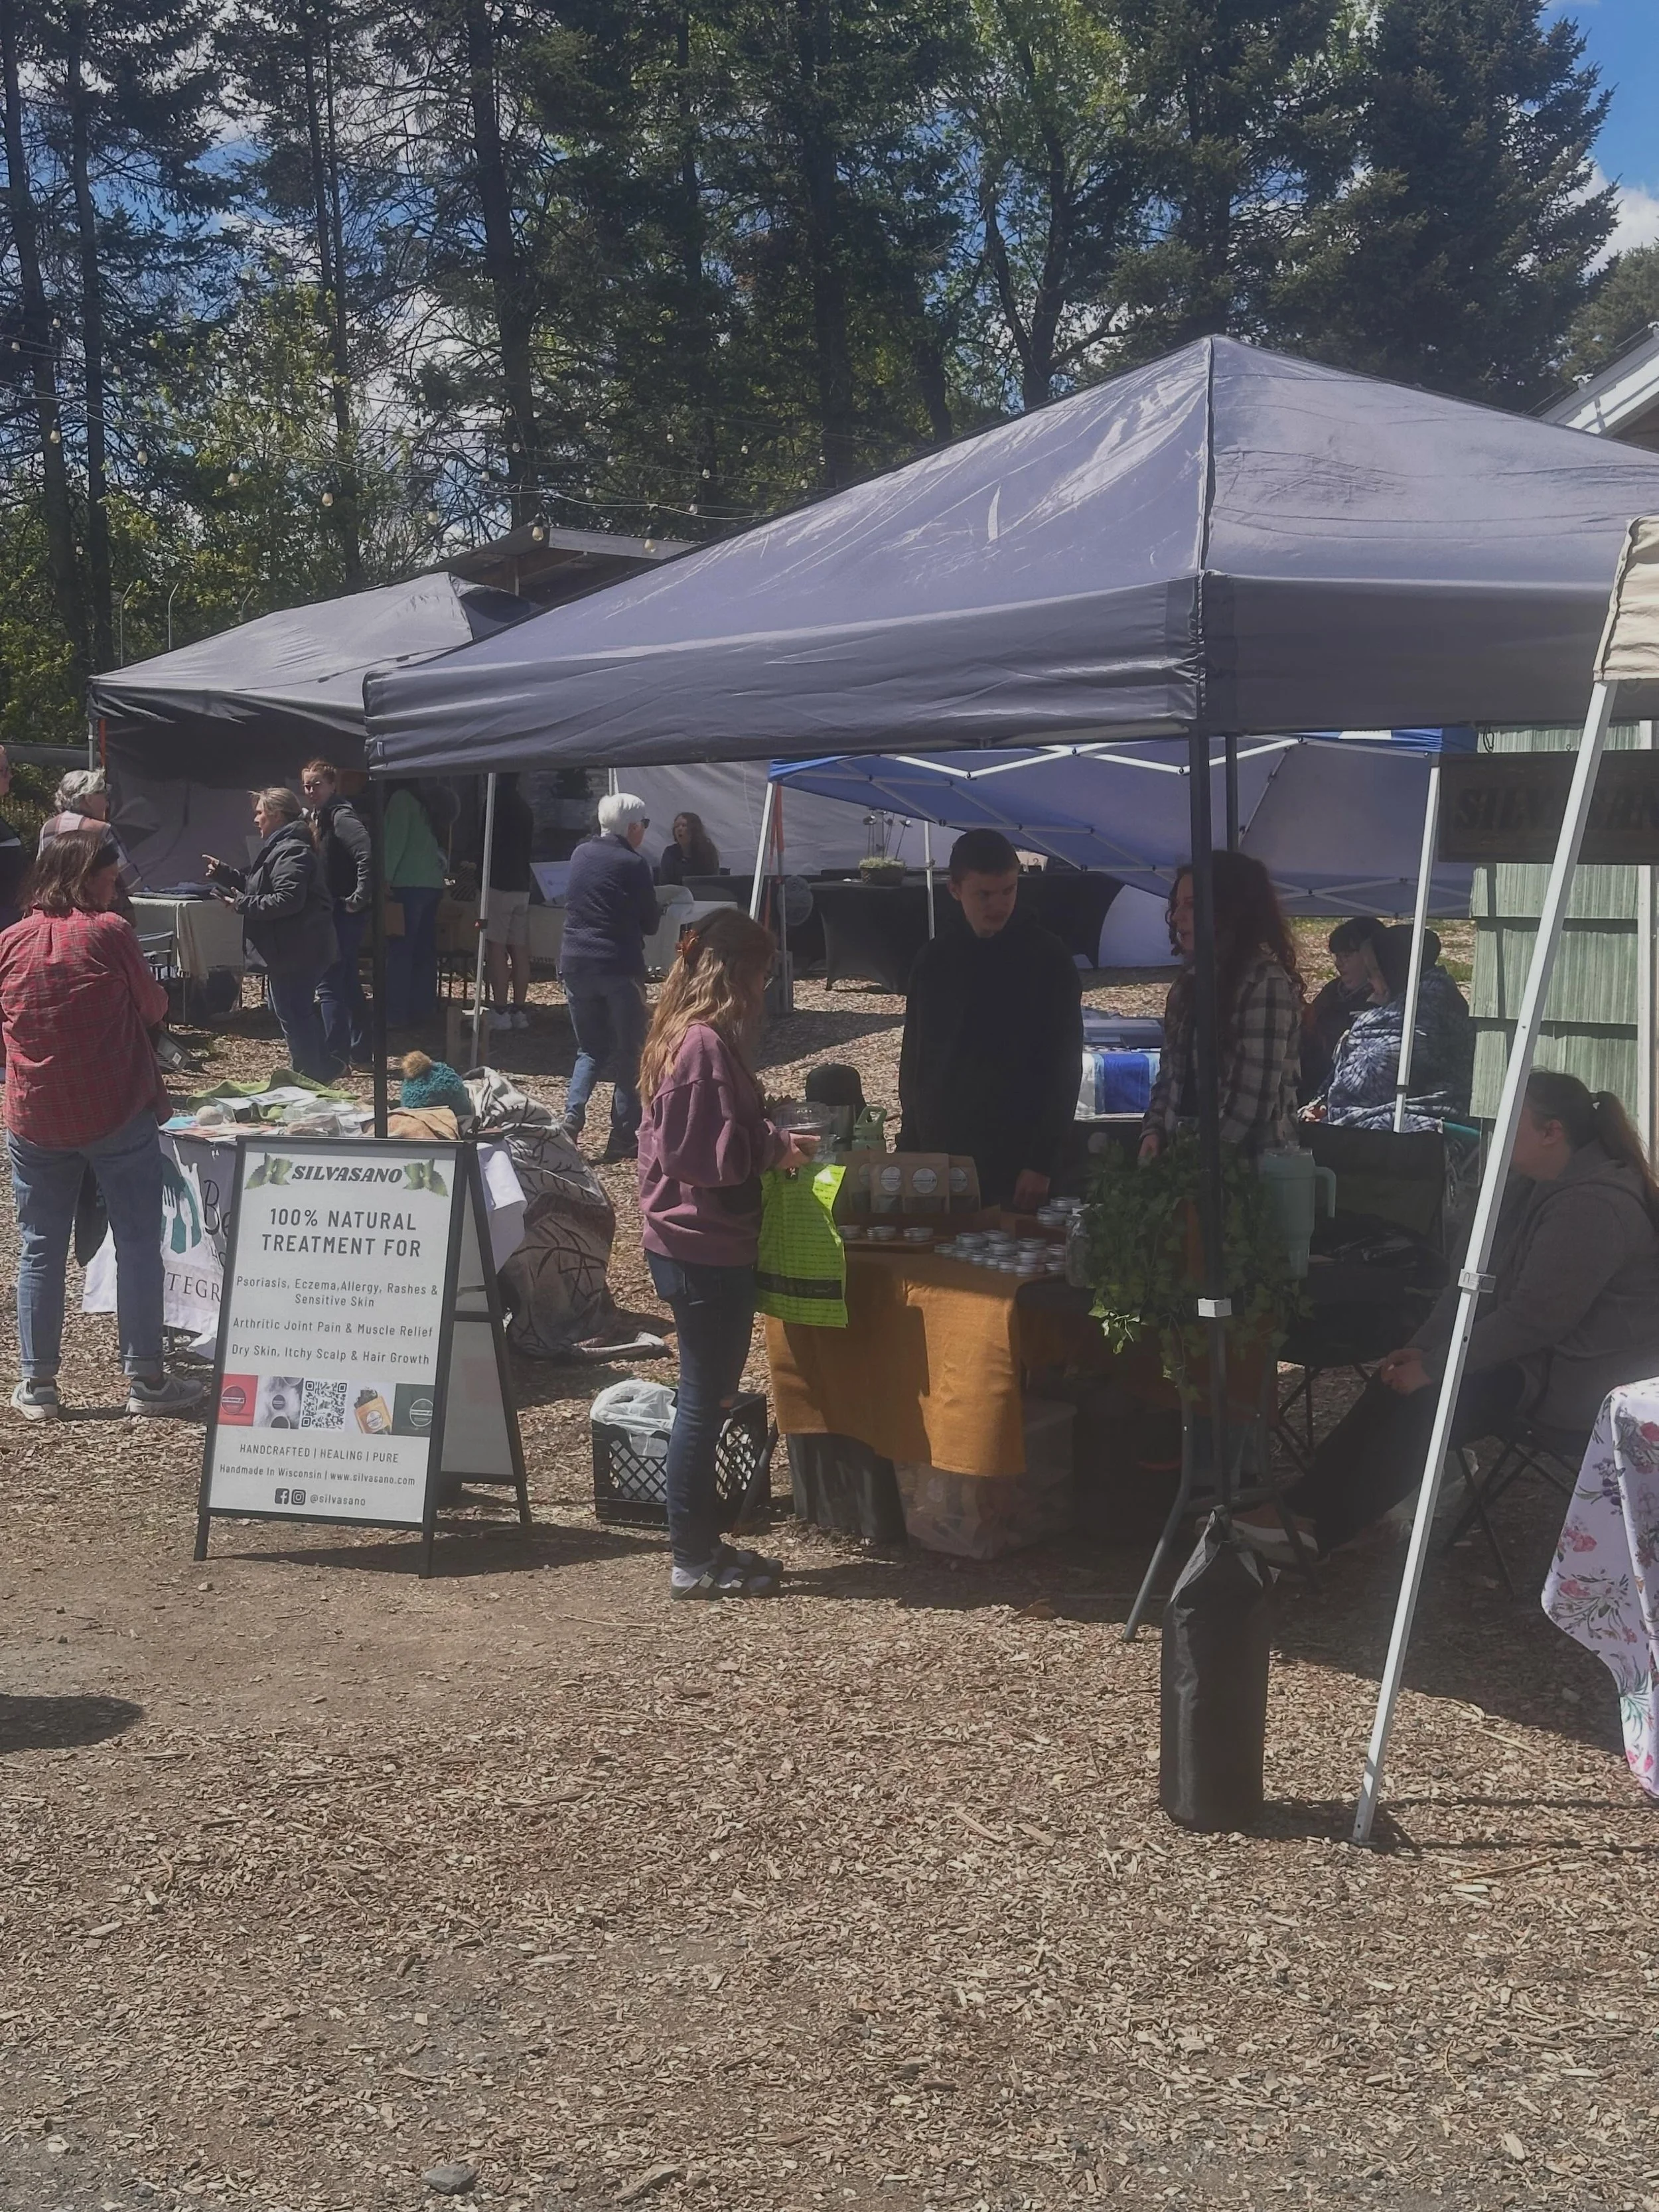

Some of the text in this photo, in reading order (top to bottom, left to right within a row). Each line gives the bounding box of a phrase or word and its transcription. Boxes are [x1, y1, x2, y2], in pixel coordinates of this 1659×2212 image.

[292, 1165, 403, 1183] SILVASANO
[270, 1208, 417, 1230] 100% NATURAL
[262, 1234, 421, 1257] TREATMENT FOR
[236, 1276, 290, 1290] Psoriasis,
[387, 1283, 426, 1295] Rashes
[431, 1285, 438, 1295] &
[295, 1293, 374, 1307] Sensitive Skin
[233, 1317, 433, 1337] Arthritic Joint Pain & Muscle Relief
[232, 1344, 429, 1364] Dry Skin, Itchy Scalp & Hair Growth
[240, 1444, 310, 1457] HANDCRAFTED
[320, 1448, 362, 1461] HEALING
[373, 1452, 399, 1463] PURE
[220, 1464, 263, 1476] Handmade
[278, 1467, 321, 1479] Wisconsin
[330, 1471, 415, 1486] www.silvasano.com
[310, 1493, 366, 1506] @silvasano
